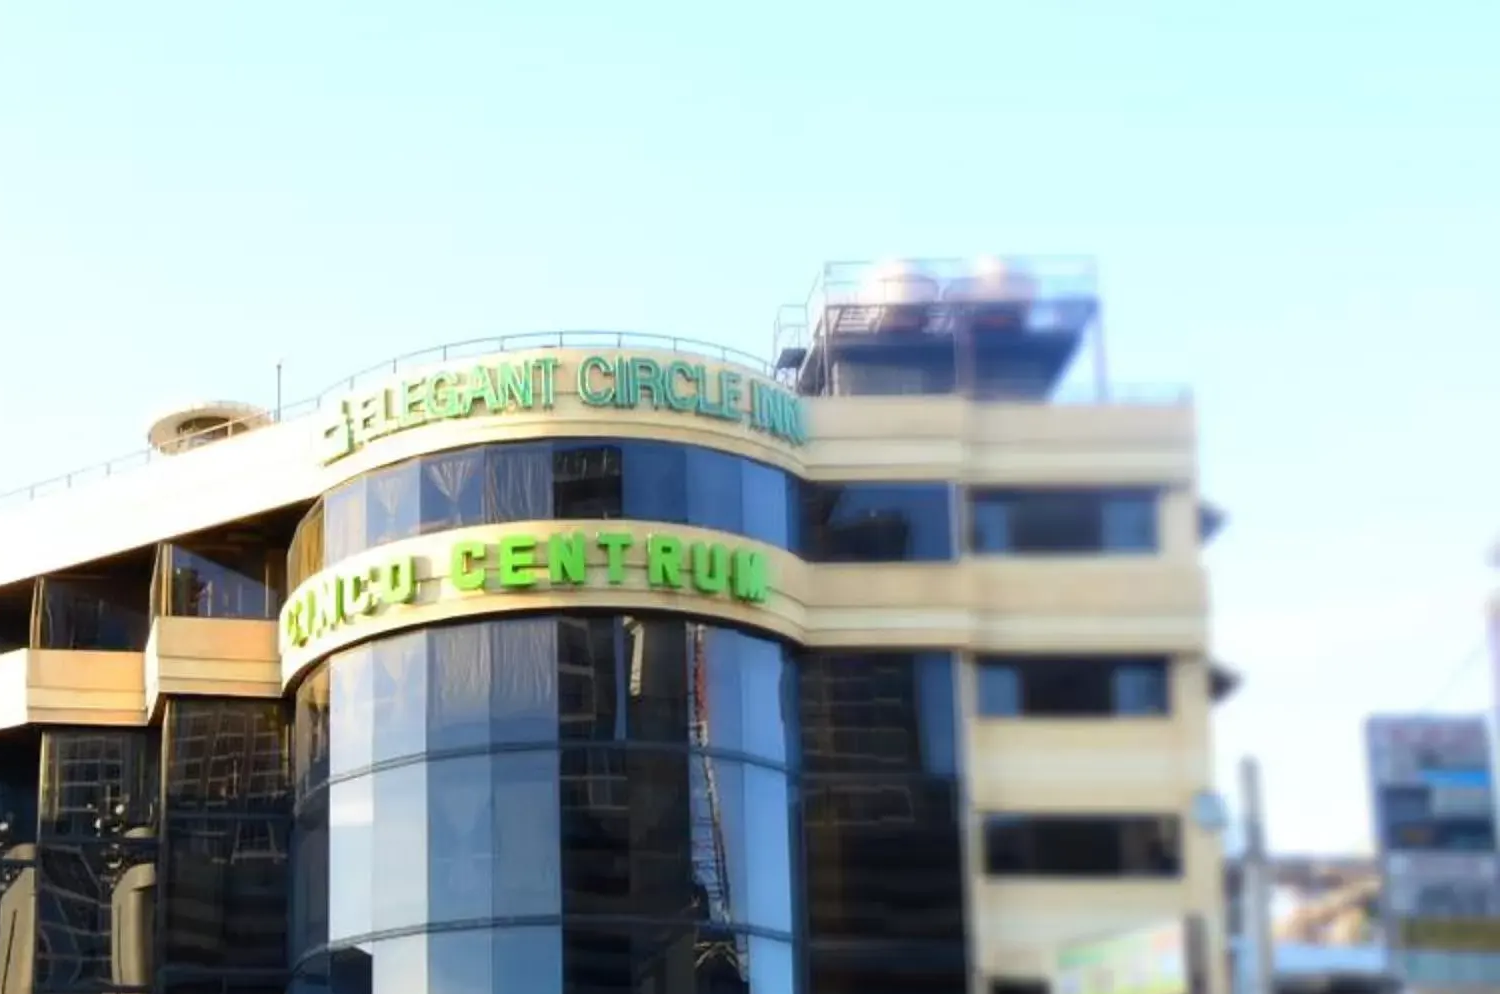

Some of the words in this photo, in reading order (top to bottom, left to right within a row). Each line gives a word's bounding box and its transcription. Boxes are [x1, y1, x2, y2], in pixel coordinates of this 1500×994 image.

[577, 355, 742, 422] CIRCLE
[750, 377, 808, 447] INN
[450, 531, 770, 602] CENTRUM
